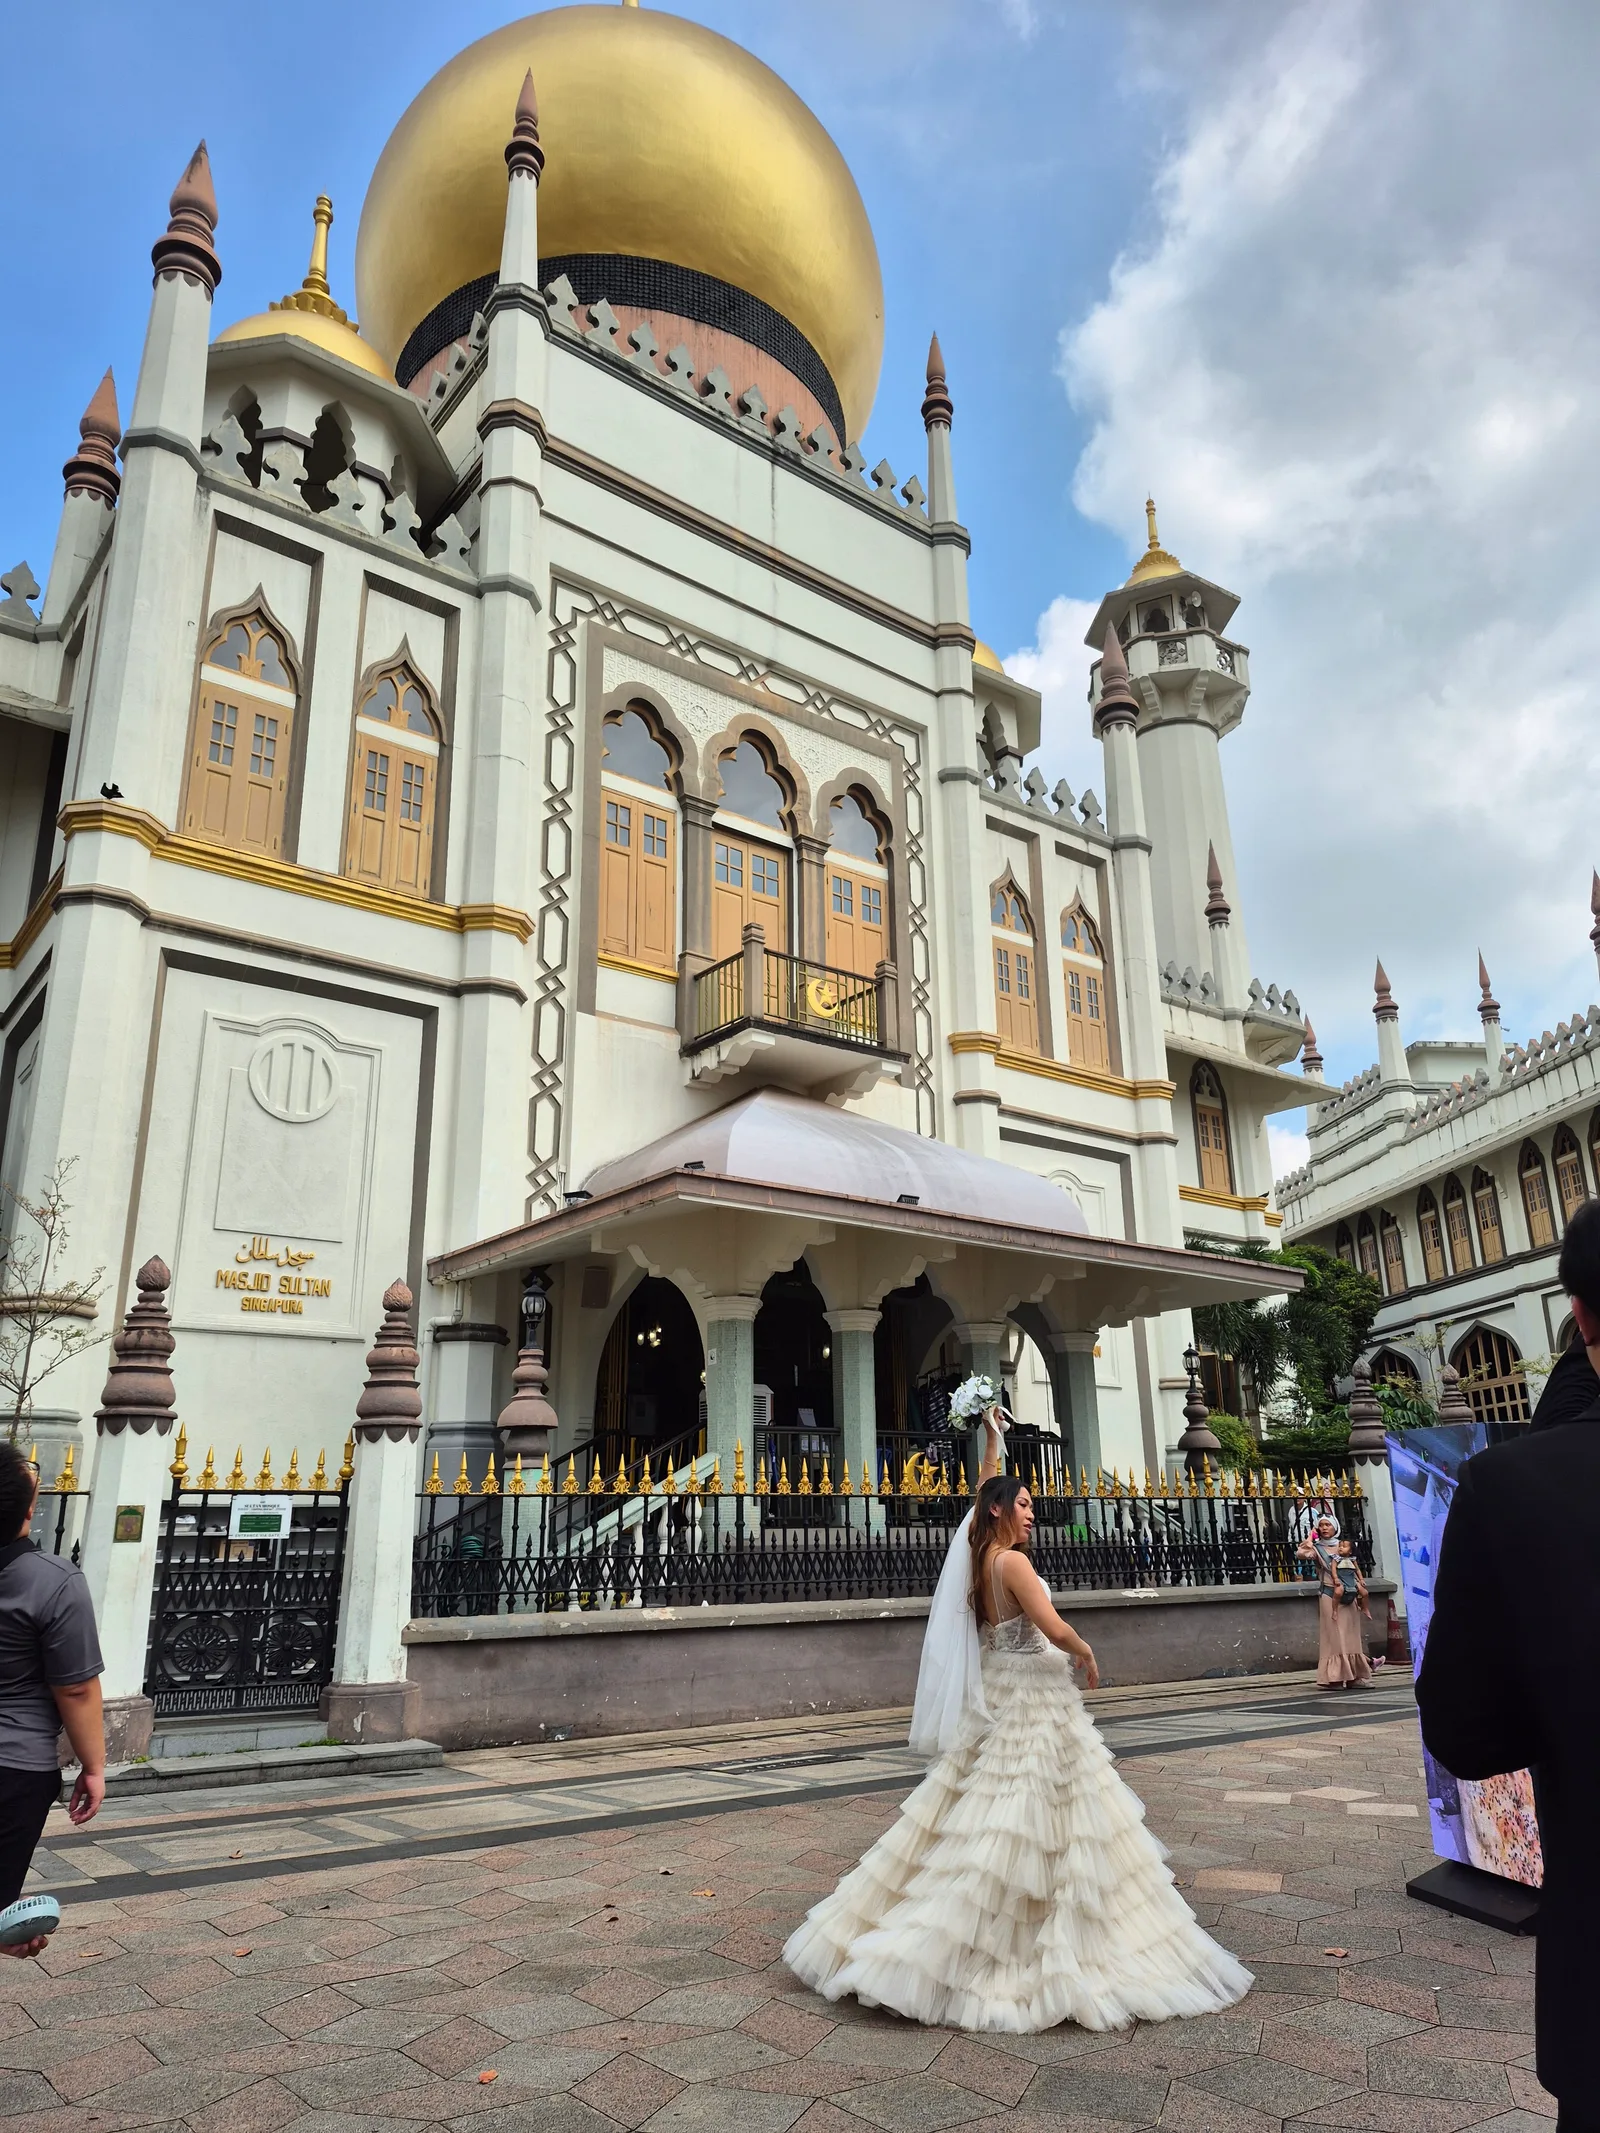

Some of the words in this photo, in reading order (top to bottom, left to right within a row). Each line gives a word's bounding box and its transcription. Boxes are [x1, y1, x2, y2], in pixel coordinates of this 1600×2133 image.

[236, 1236, 279, 1263] سلطان
[277, 1246, 316, 1271] مسجد
[216, 1269, 271, 1292] MASJID
[279, 1275, 331, 1297] SULTAN
[241, 1297, 303, 1314] SINGAPURA
